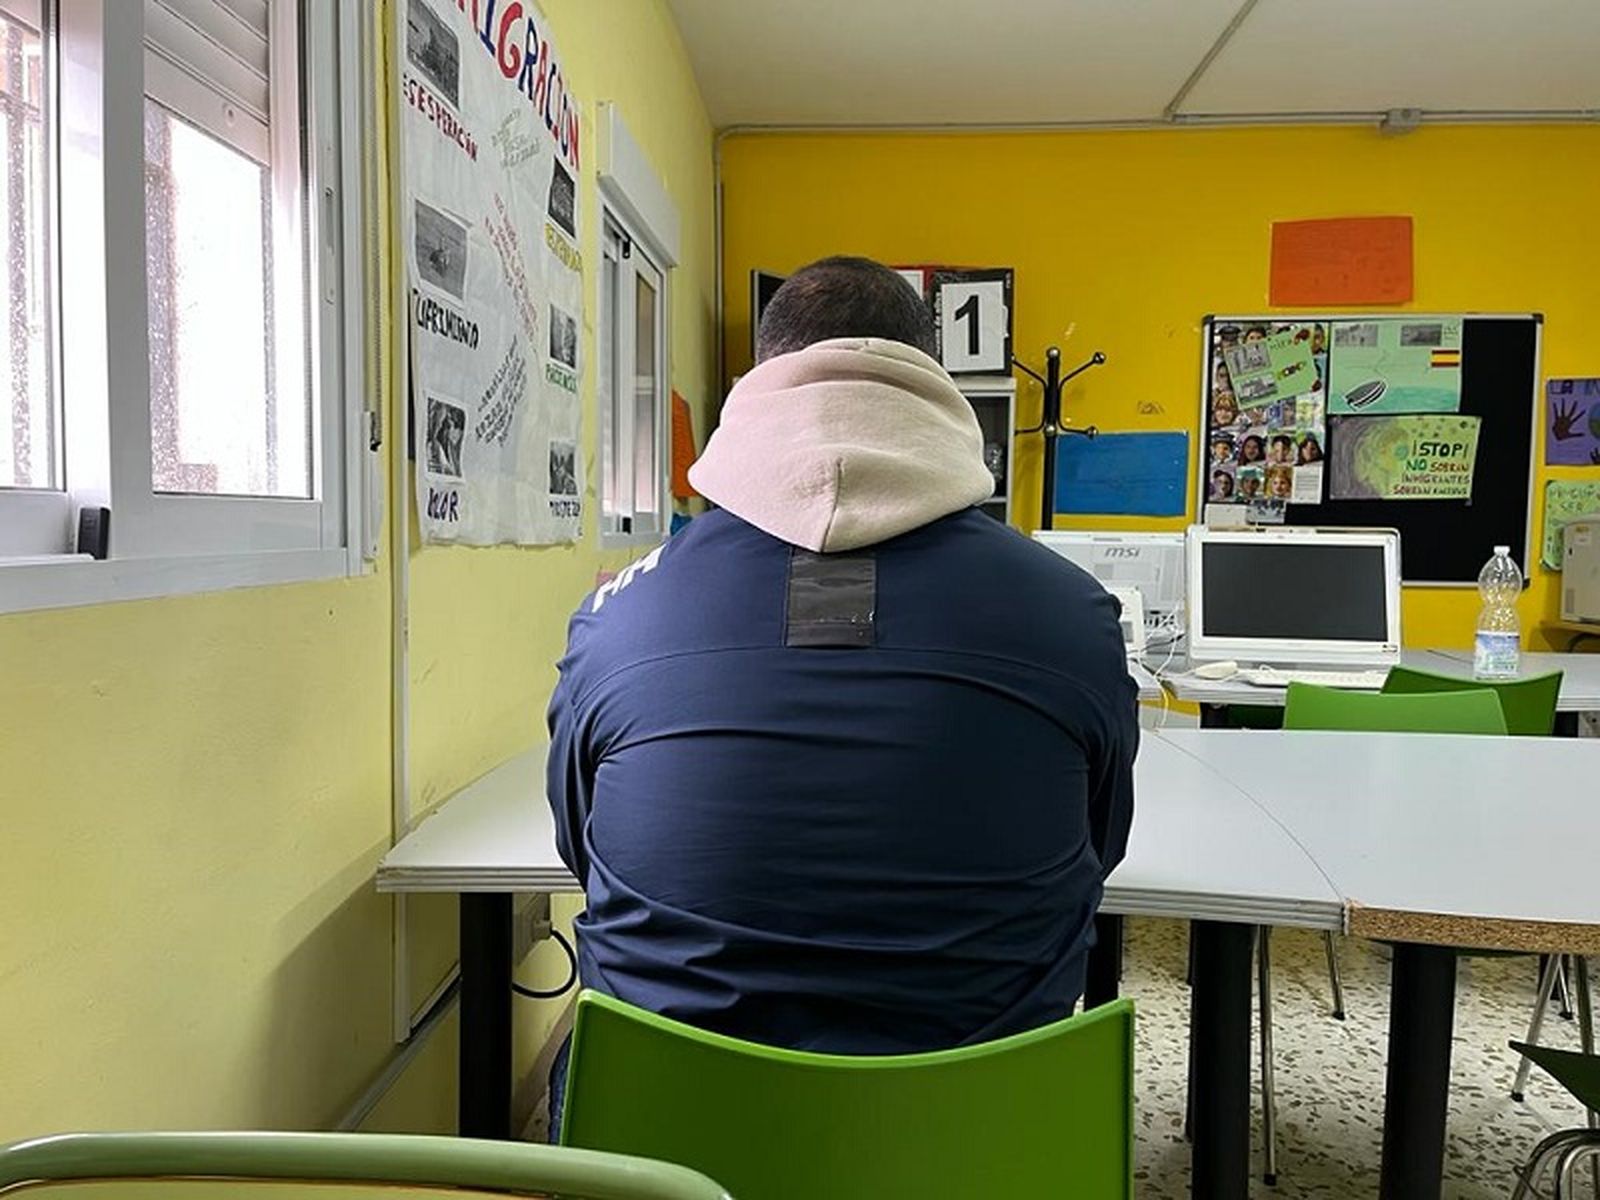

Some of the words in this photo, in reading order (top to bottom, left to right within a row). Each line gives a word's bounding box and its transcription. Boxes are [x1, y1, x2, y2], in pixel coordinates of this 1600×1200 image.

[954, 294, 980, 355] 1
[1406, 459, 1428, 471] NO
[1105, 547, 1141, 557] msi
